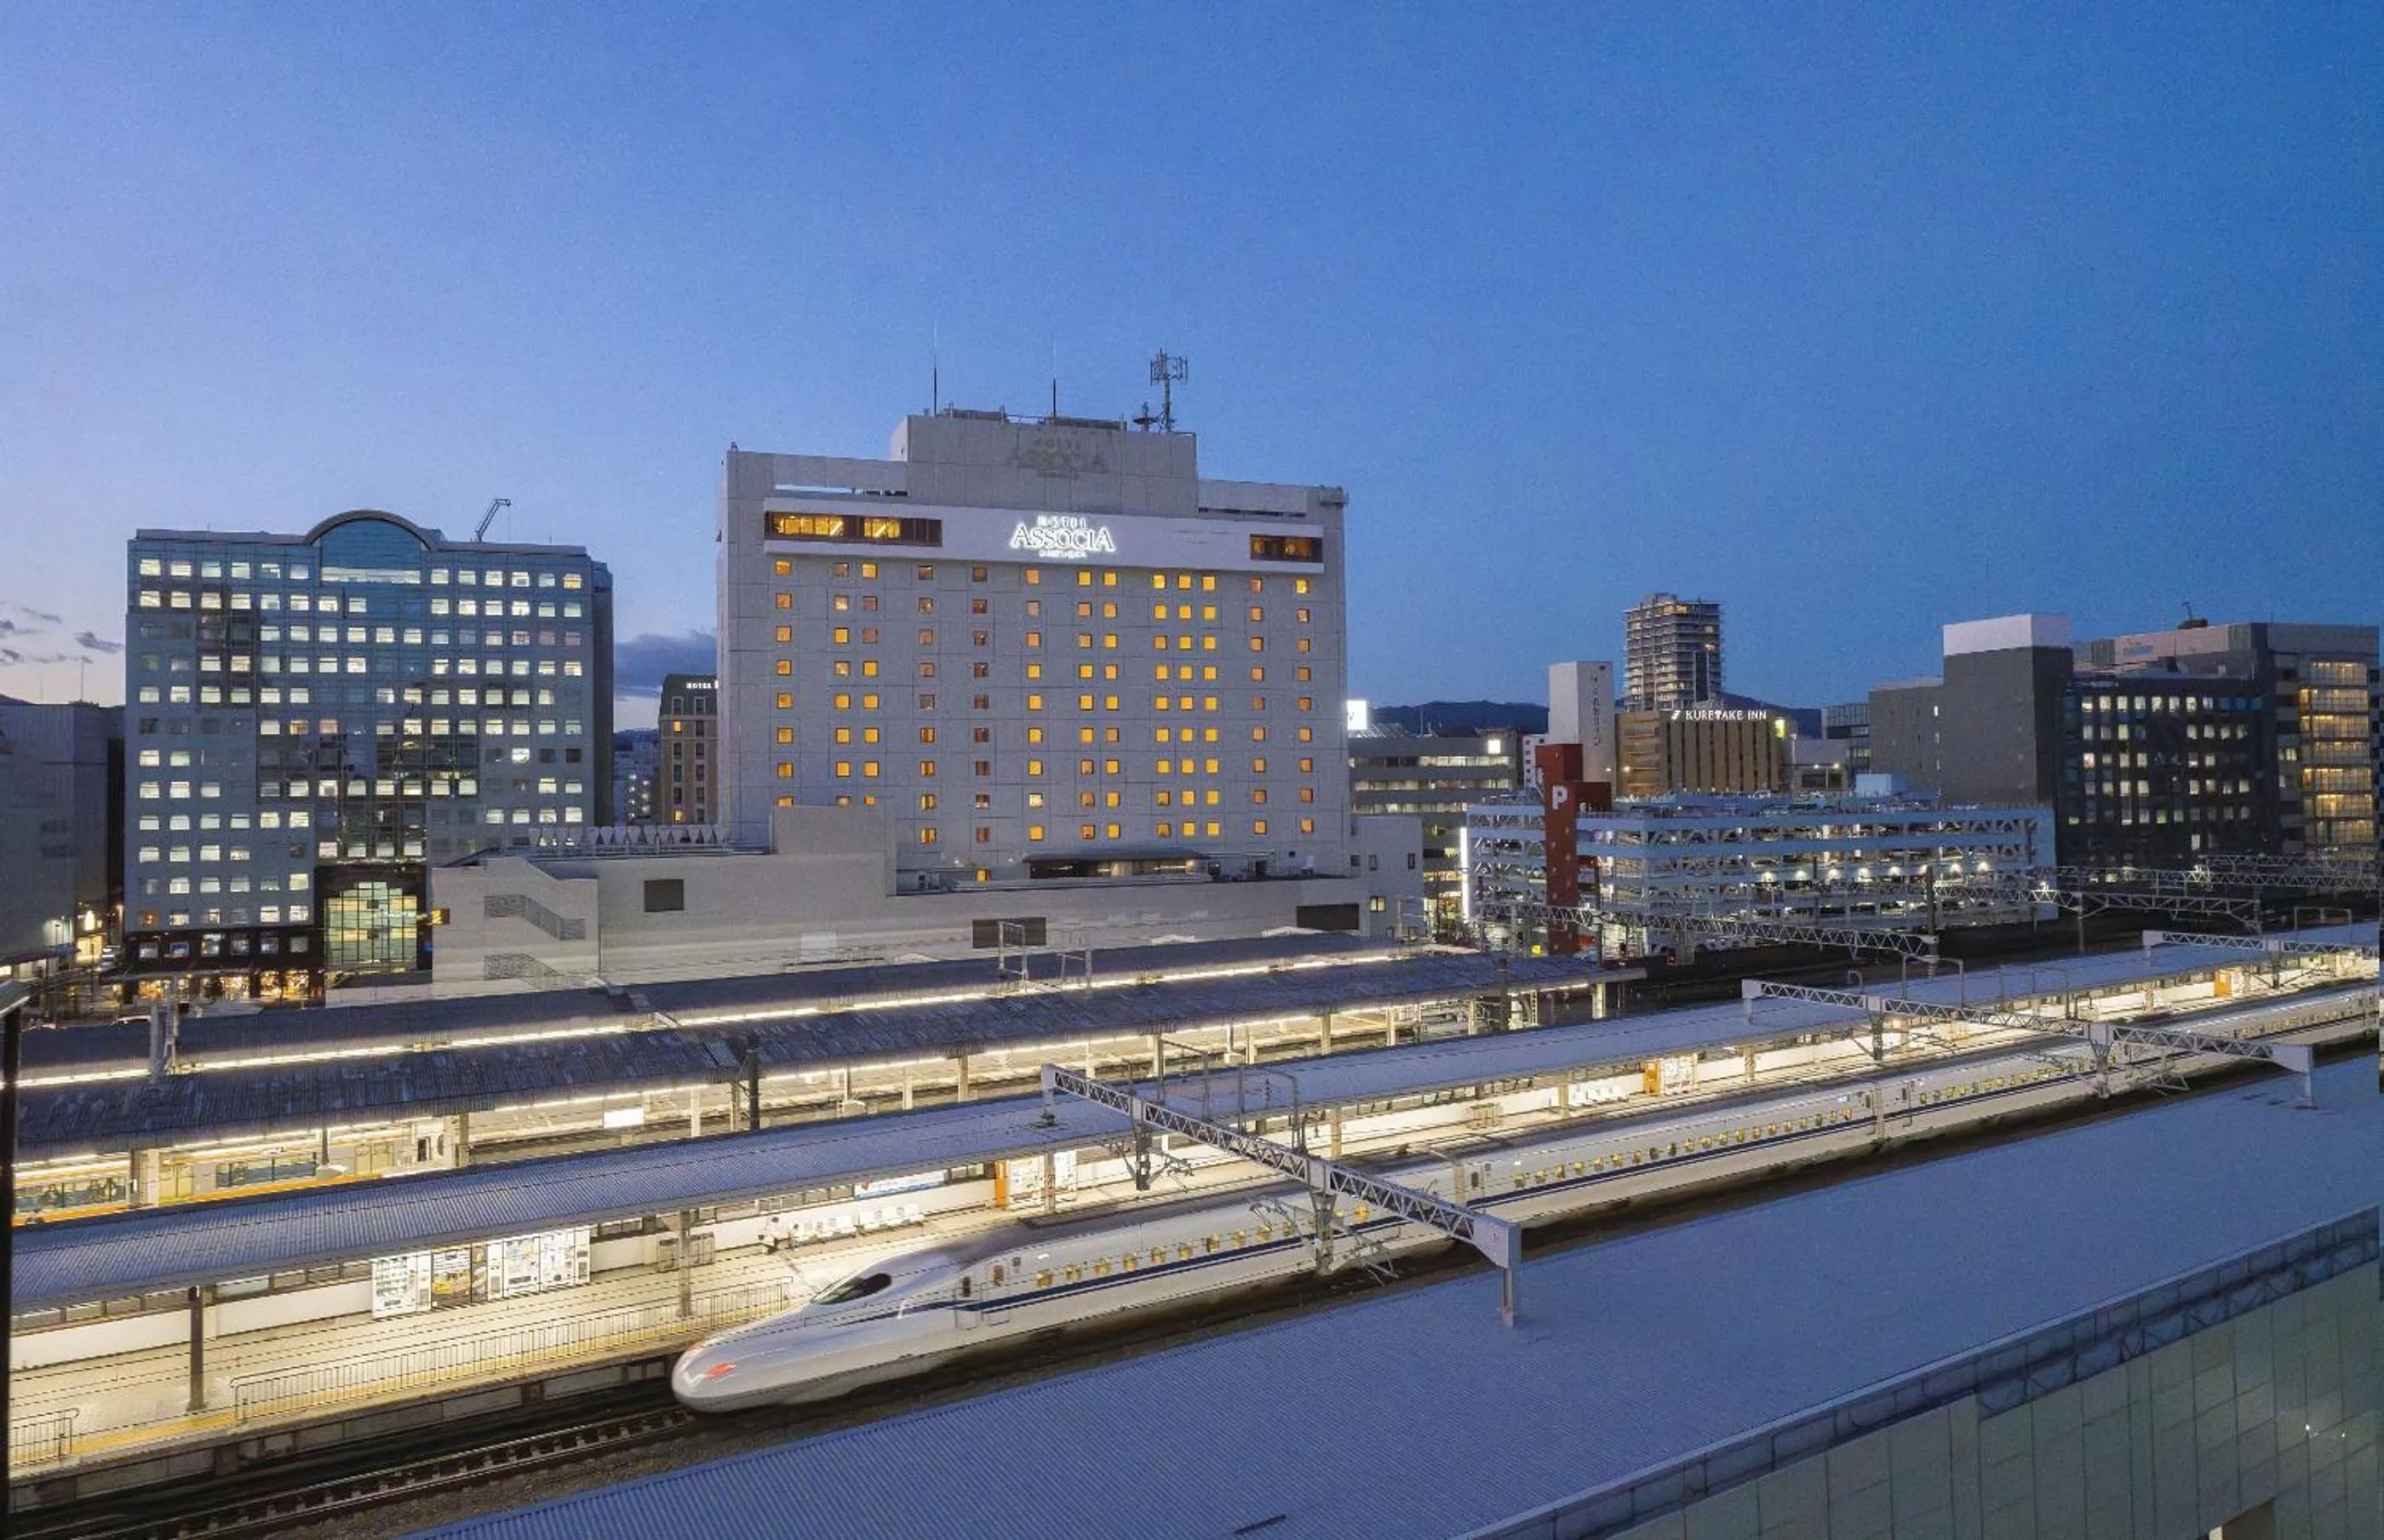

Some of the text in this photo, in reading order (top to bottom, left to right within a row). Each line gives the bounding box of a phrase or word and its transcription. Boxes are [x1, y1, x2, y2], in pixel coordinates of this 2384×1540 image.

[1010, 522, 1116, 552] ASSOCIA
[1747, 710, 1767, 720] INN
[1552, 786, 1567, 810] P
